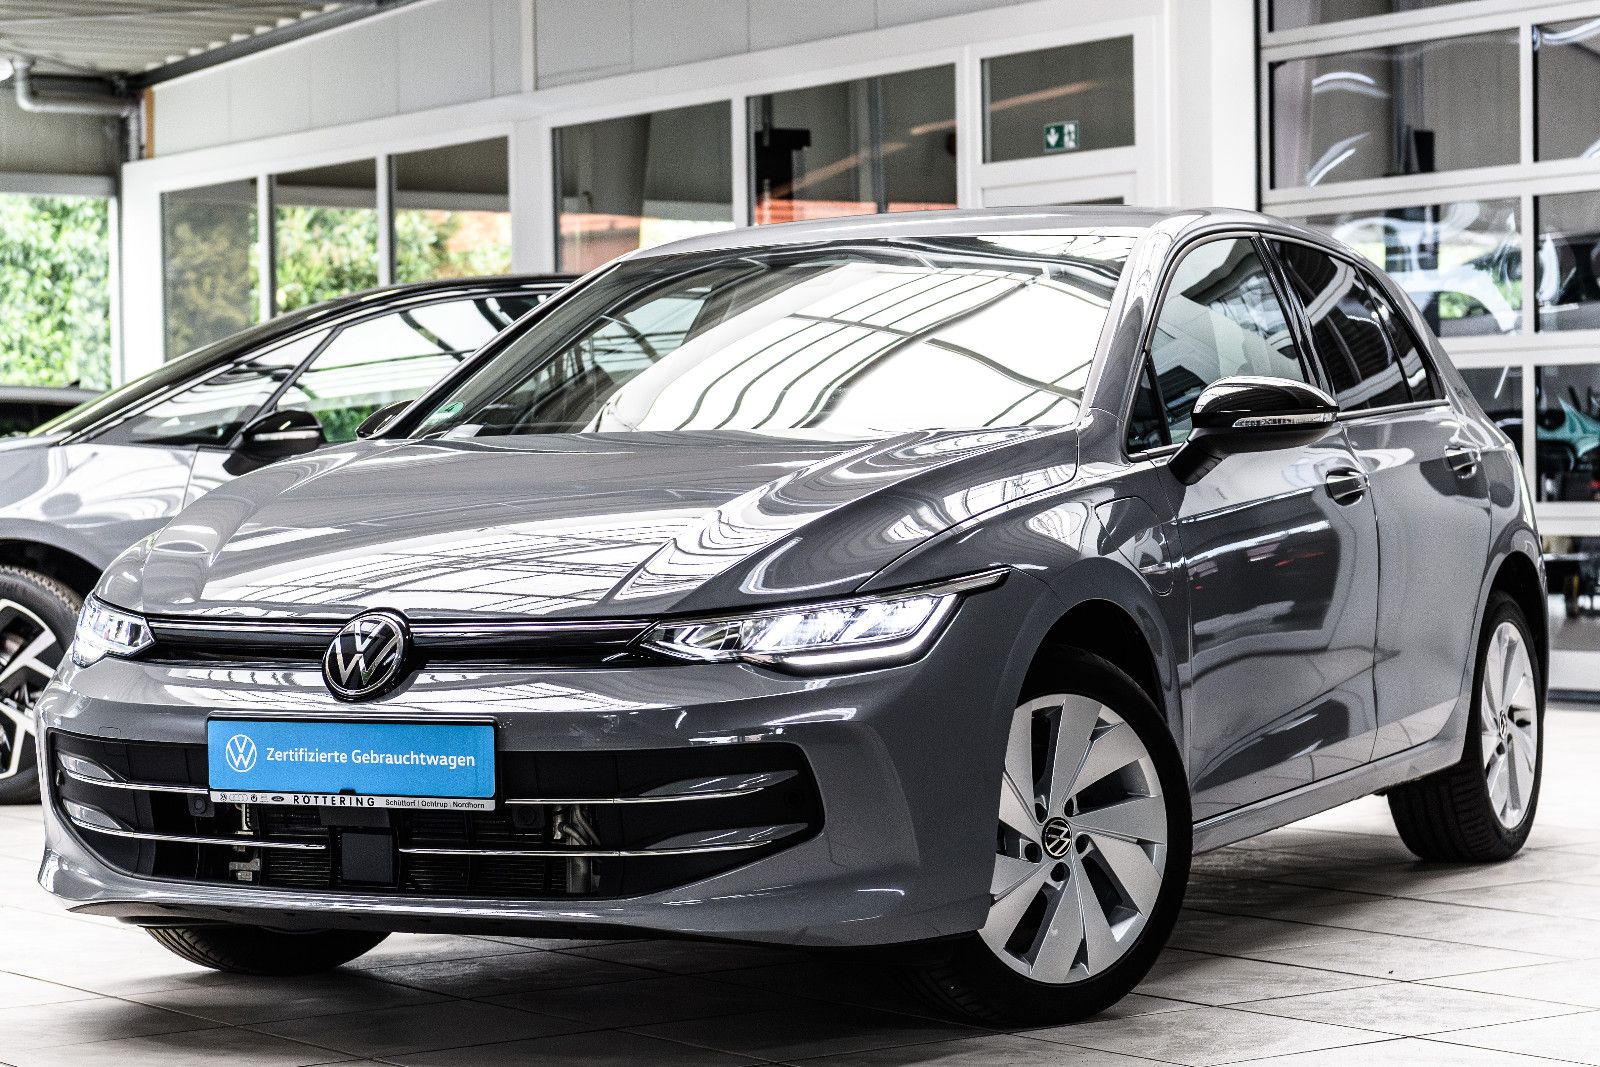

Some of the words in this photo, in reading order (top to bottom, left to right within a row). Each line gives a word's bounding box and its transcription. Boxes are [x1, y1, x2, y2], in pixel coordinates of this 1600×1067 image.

[266, 747, 348, 763] Zertifizierte
[351, 749, 476, 769] Gebrauchtwagen
[293, 795, 375, 807] RÖTTERING
[421, 800, 448, 808] Ochtrup
[452, 801, 485, 809] Nordhorn
